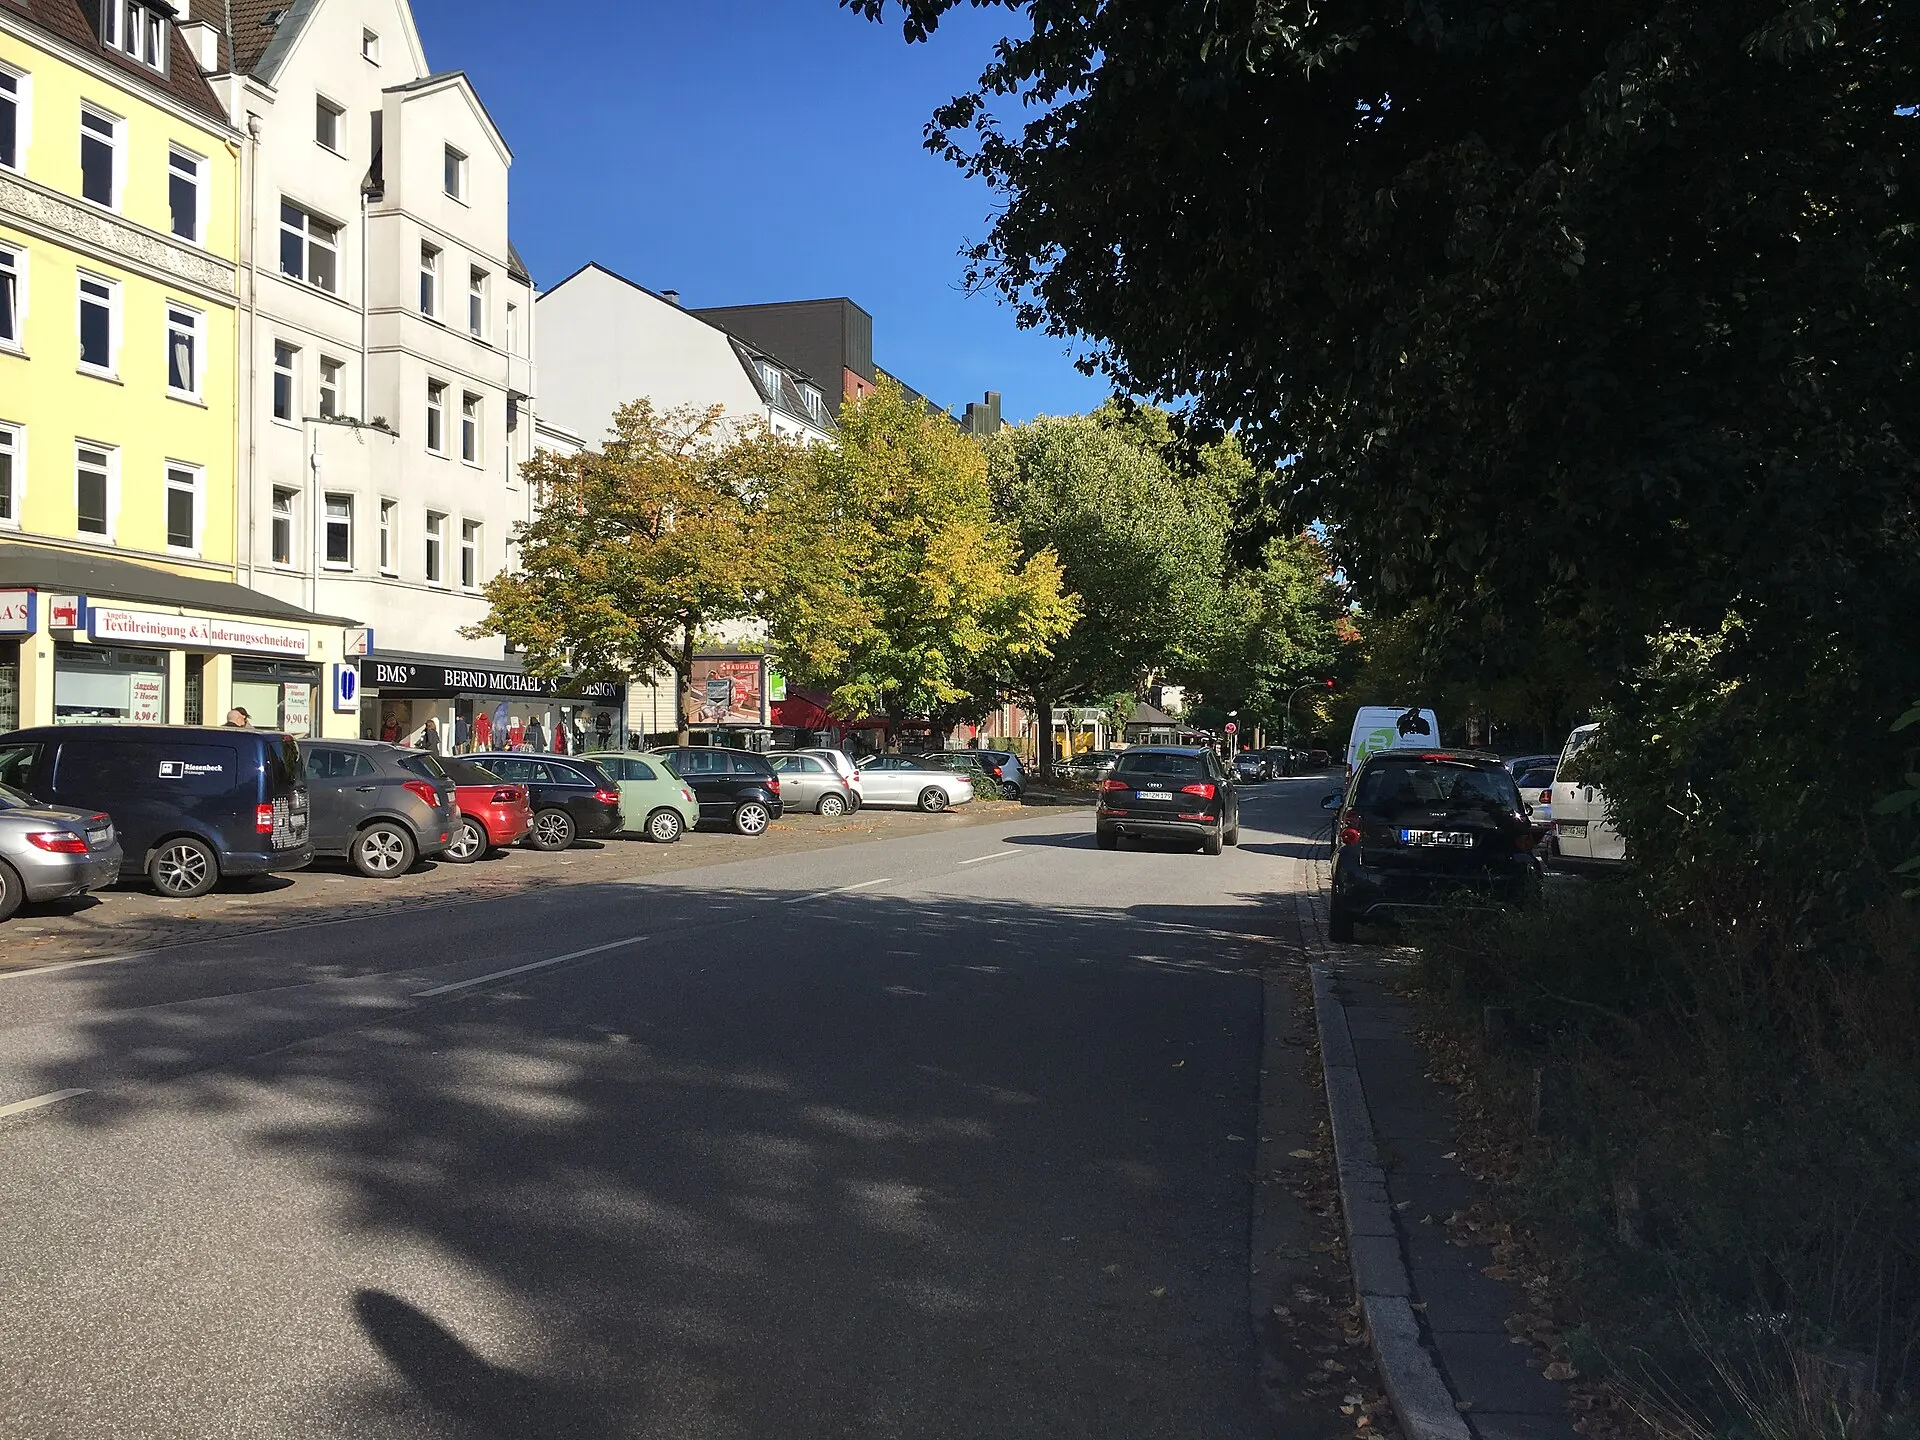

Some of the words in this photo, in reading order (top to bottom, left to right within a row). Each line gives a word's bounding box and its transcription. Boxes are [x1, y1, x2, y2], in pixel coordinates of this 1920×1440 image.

[0, 604, 28, 620] A'S
[104, 618, 187, 639] Textilreinigung
[189, 626, 198, 638] &
[376, 664, 407, 683] BMS
[444, 669, 487, 688] BERND
[134, 711, 151, 721] 8,90
[286, 714, 302, 725] 9,90
[1409, 831, 1423, 843] HH
